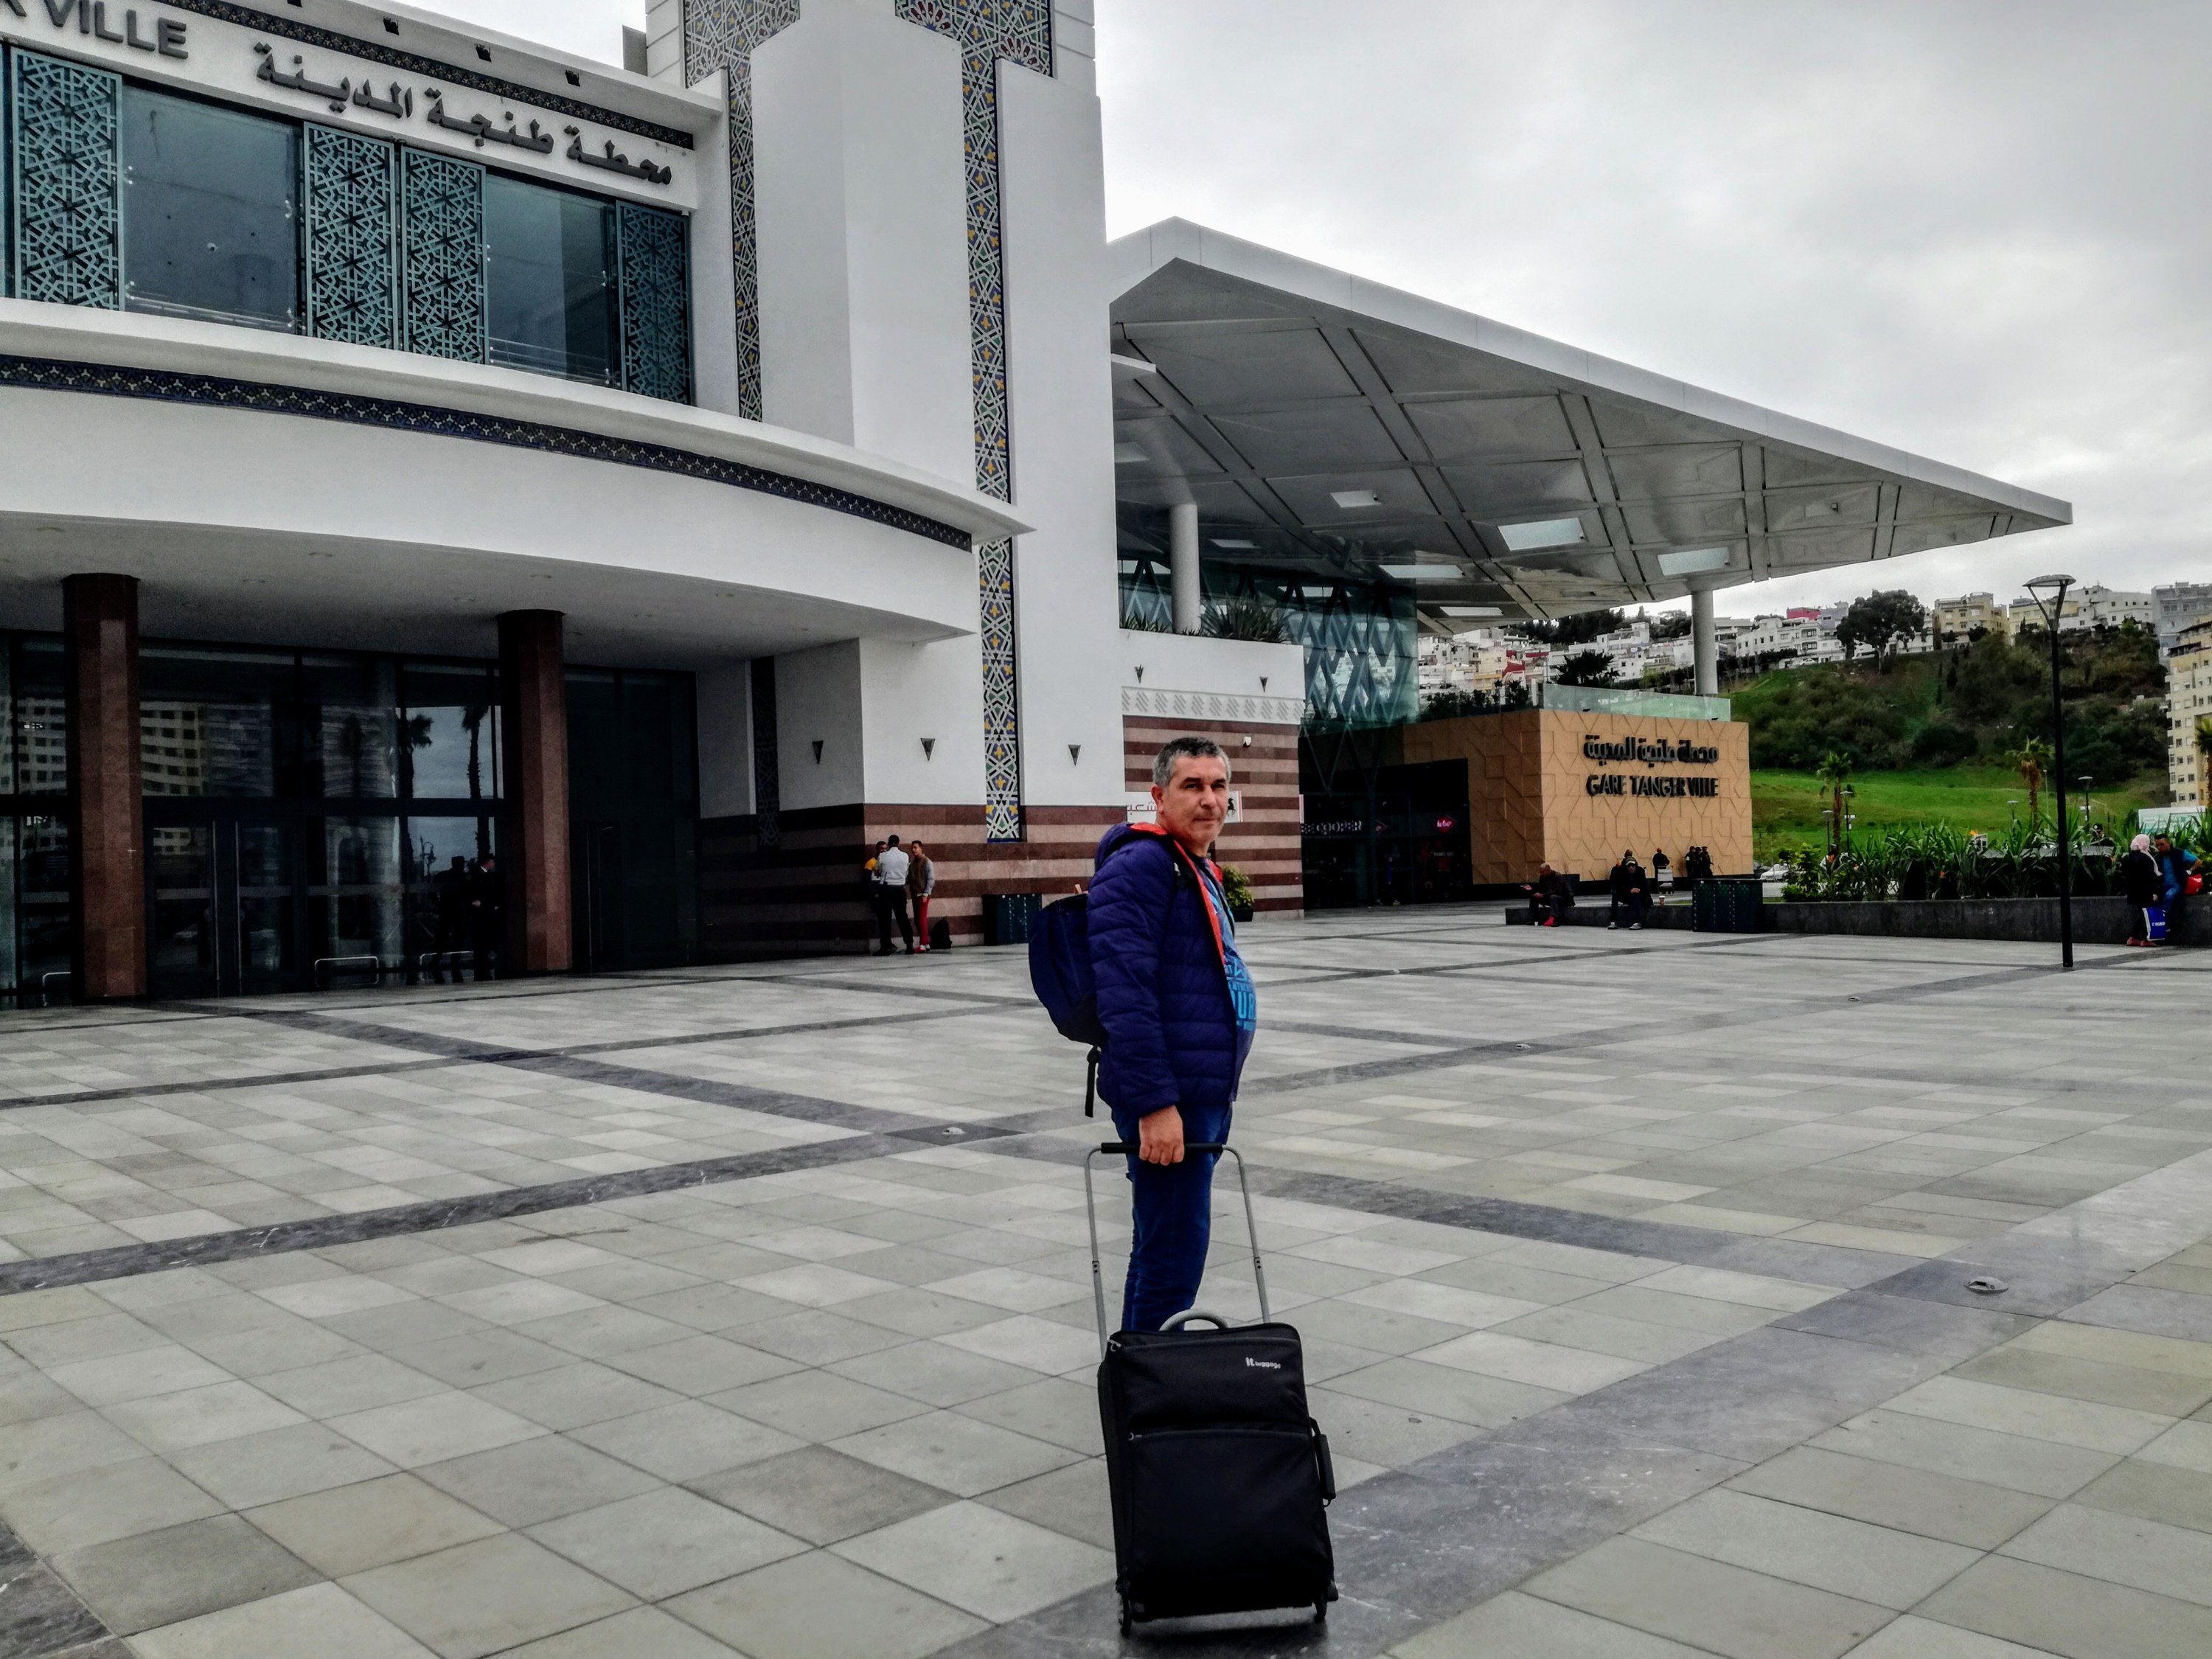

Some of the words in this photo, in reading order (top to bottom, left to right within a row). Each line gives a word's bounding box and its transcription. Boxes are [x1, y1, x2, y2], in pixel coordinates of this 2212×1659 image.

[44, 0, 189, 60] VILLE
[256, 42, 414, 119] المدينة
[425, 87, 555, 153] طنجة
[566, 125, 673, 186] محطة
[1583, 734, 1636, 767] المدينة
[1637, 738, 1677, 768] طنجة
[1677, 739, 1719, 764] محطة
[1586, 773, 1627, 797] GARE
[1629, 775, 1687, 798] TANGER
[1686, 777, 1719, 798] VILLE
